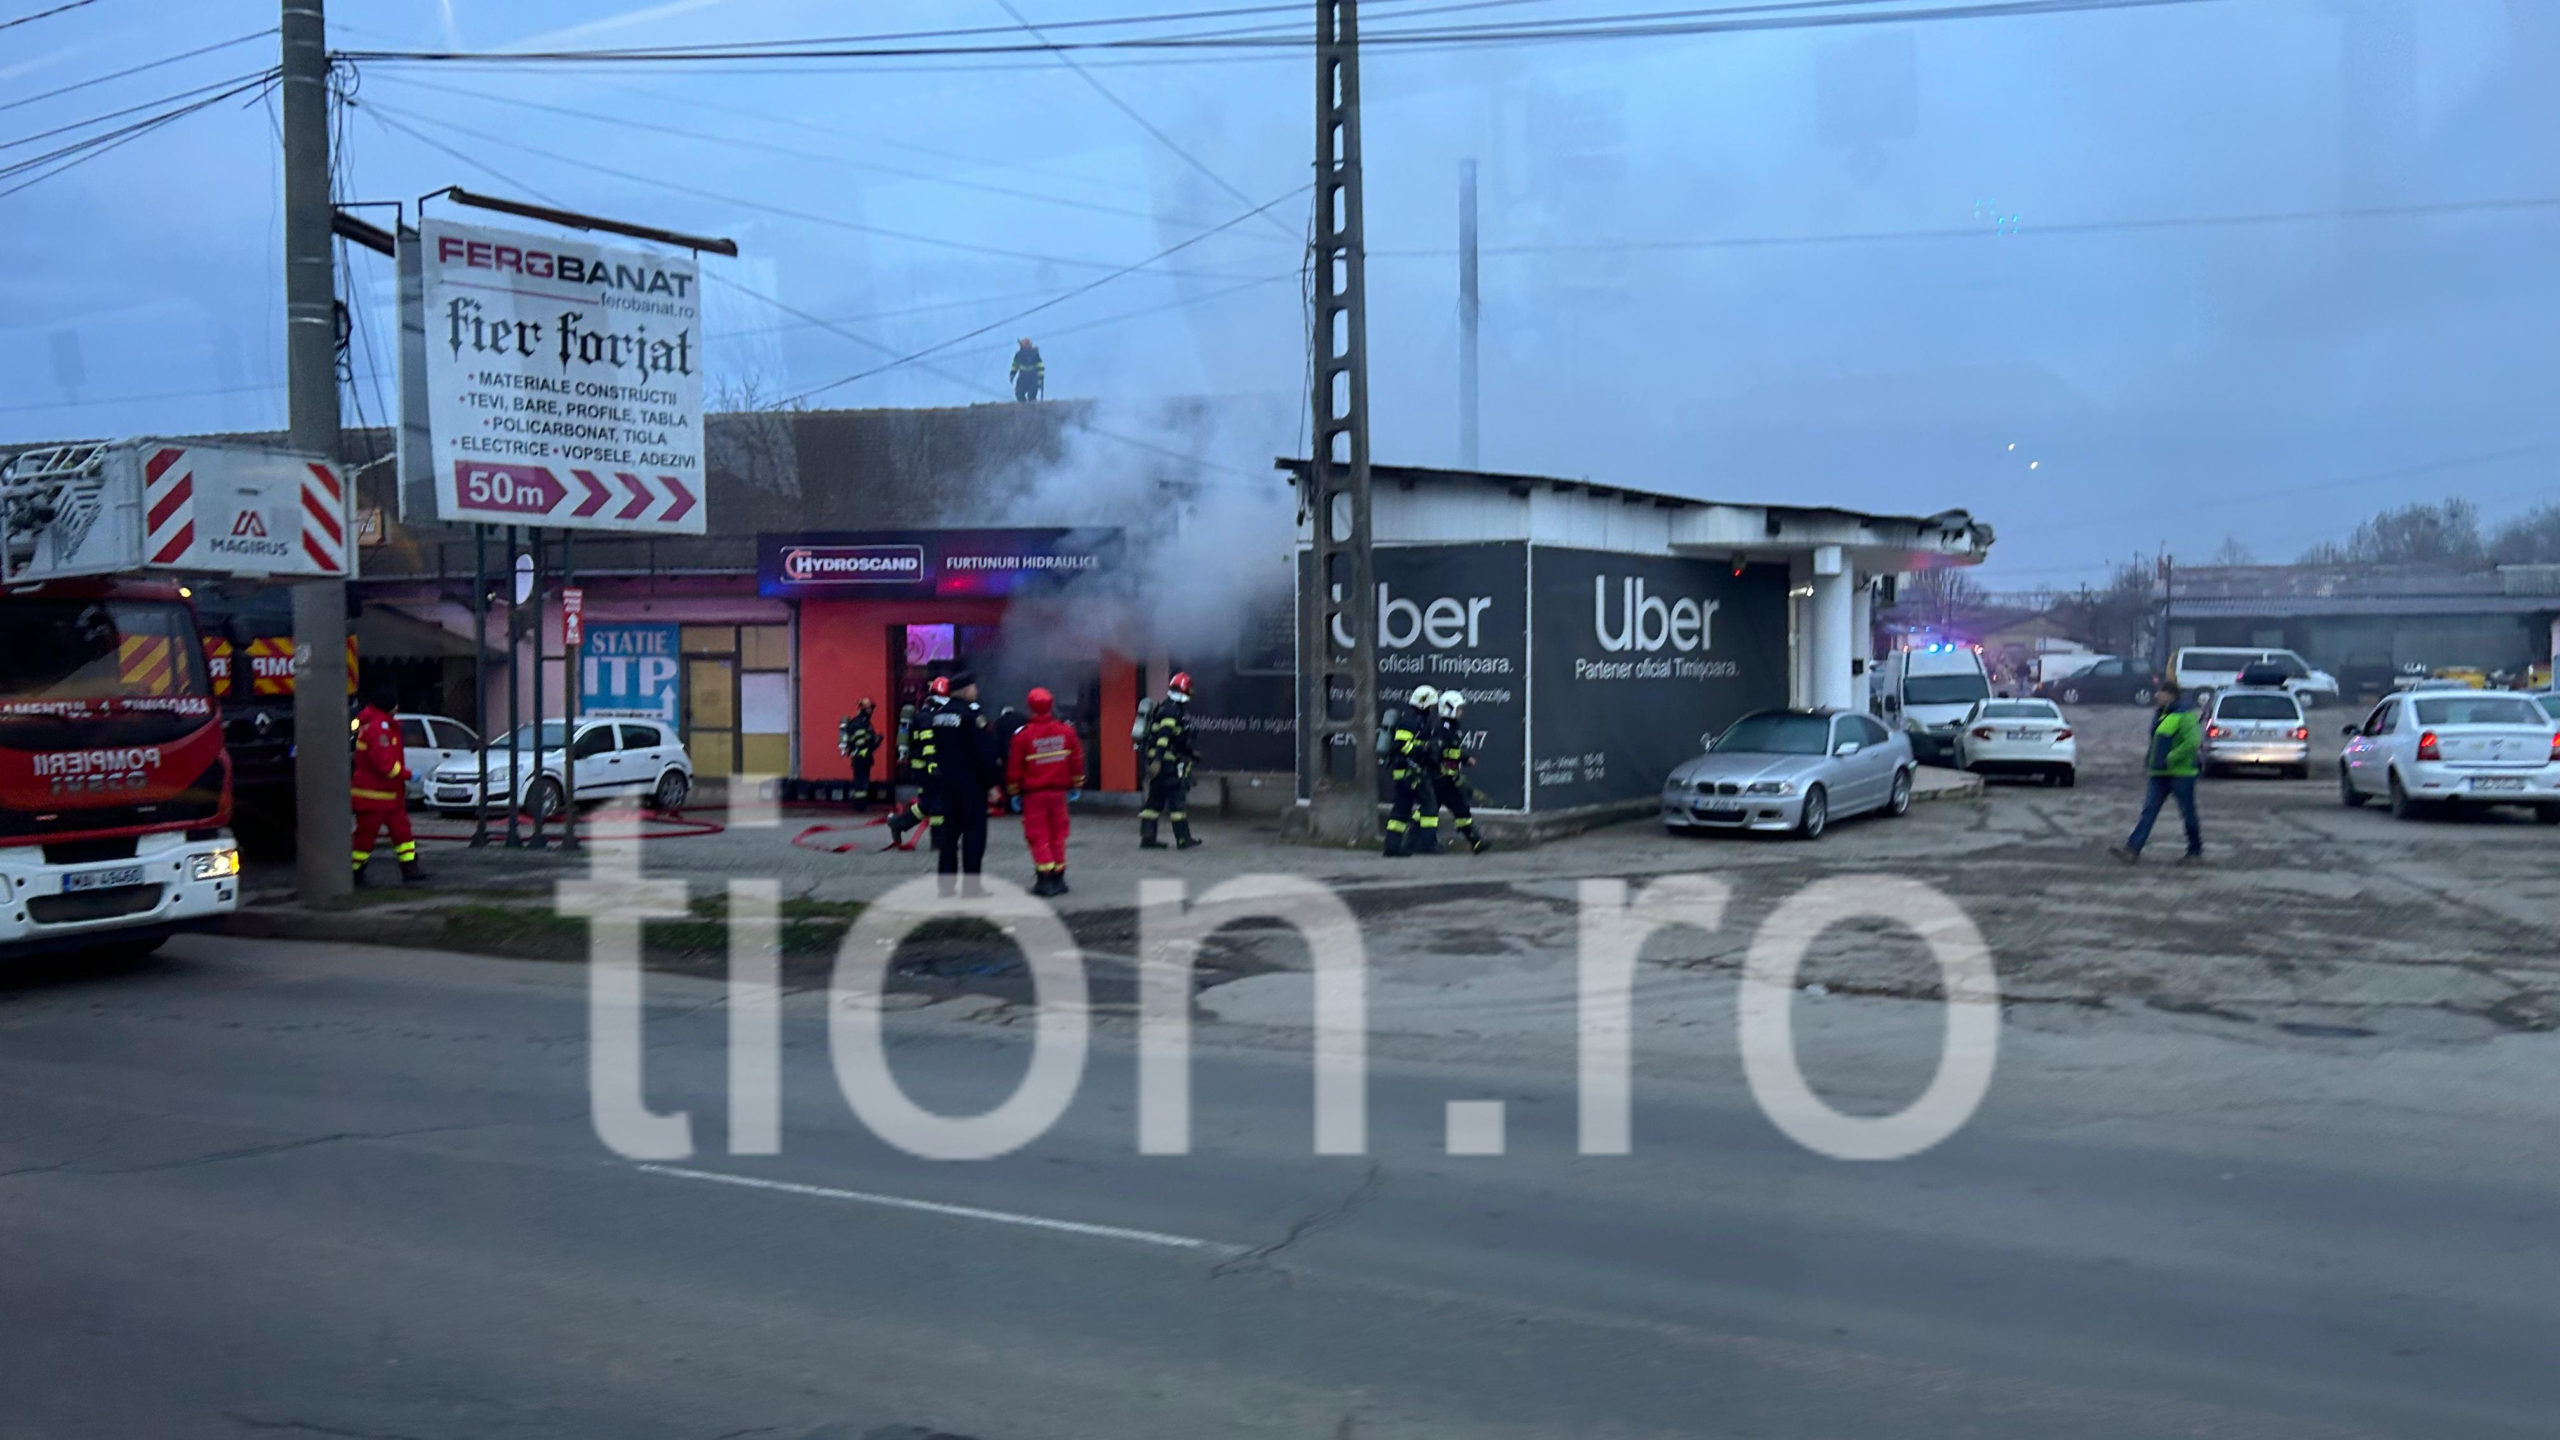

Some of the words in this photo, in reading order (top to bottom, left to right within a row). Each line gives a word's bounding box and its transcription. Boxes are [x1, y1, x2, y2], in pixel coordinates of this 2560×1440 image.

[438, 236, 693, 298] FEROBANAT
[601, 292, 694, 319] ferobanat.ro
[446, 296, 542, 363] fier
[557, 310, 694, 386] forjat
[479, 372, 571, 394] MATERIALE
[575, 378, 677, 405] CONSTRUCTII
[467, 393, 509, 412] TEVI,
[514, 397, 562, 418] BARE,
[566, 402, 636, 425] PROFILE,
[640, 410, 688, 428] TABLA
[493, 417, 620, 444] POLICARBONAT,
[624, 429, 668, 446] TIGLA
[461, 436, 549, 457] ELECTRICE
[562, 445, 636, 466] VOPSELE,
[639, 452, 696, 469] ADEZIVI
[468, 470, 544, 507] 50m
[209, 538, 289, 556] MAGIRUS
[946, 556, 1019, 571] FURTUNURI
[1022, 556, 1098, 570] HIDRAULICE
[797, 556, 918, 573] HYDROSCAND
[1595, 575, 1720, 652] Uber
[584, 656, 678, 697] ITP
[1378, 652, 1425, 673] oficial
[1575, 658, 1634, 681] Partener
[1635, 657, 1672, 679] oficial
